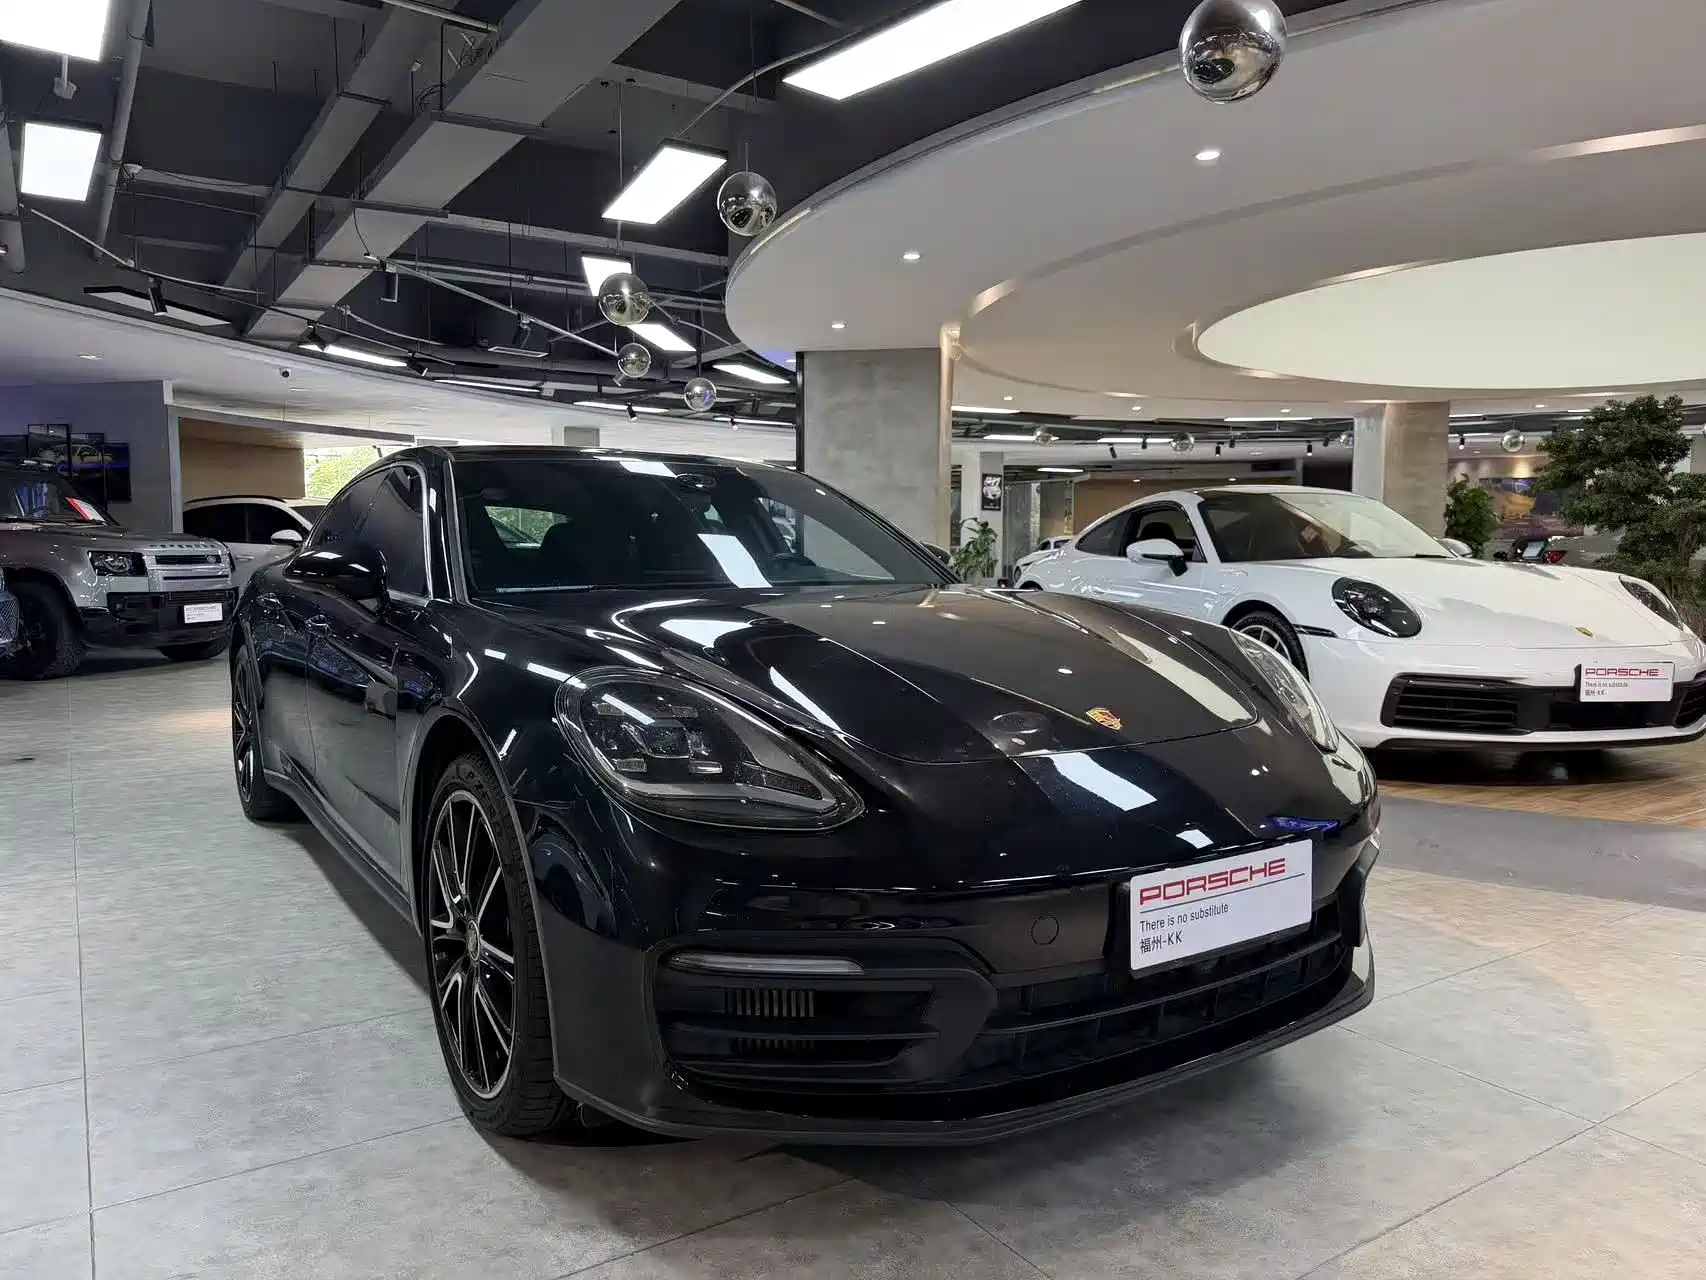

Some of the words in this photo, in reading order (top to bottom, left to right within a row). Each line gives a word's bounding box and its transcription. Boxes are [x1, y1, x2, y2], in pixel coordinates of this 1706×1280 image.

[1585, 668, 1659, 676] PORSCHE
[1139, 857, 1286, 905] PORSCHE
[1139, 918, 1165, 933] There
[1168, 914, 1175, 926] is
[1177, 913, 1188, 924] no
[1190, 903, 1229, 921] substitute
[1139, 930, 1182, 954] 福州-KK
